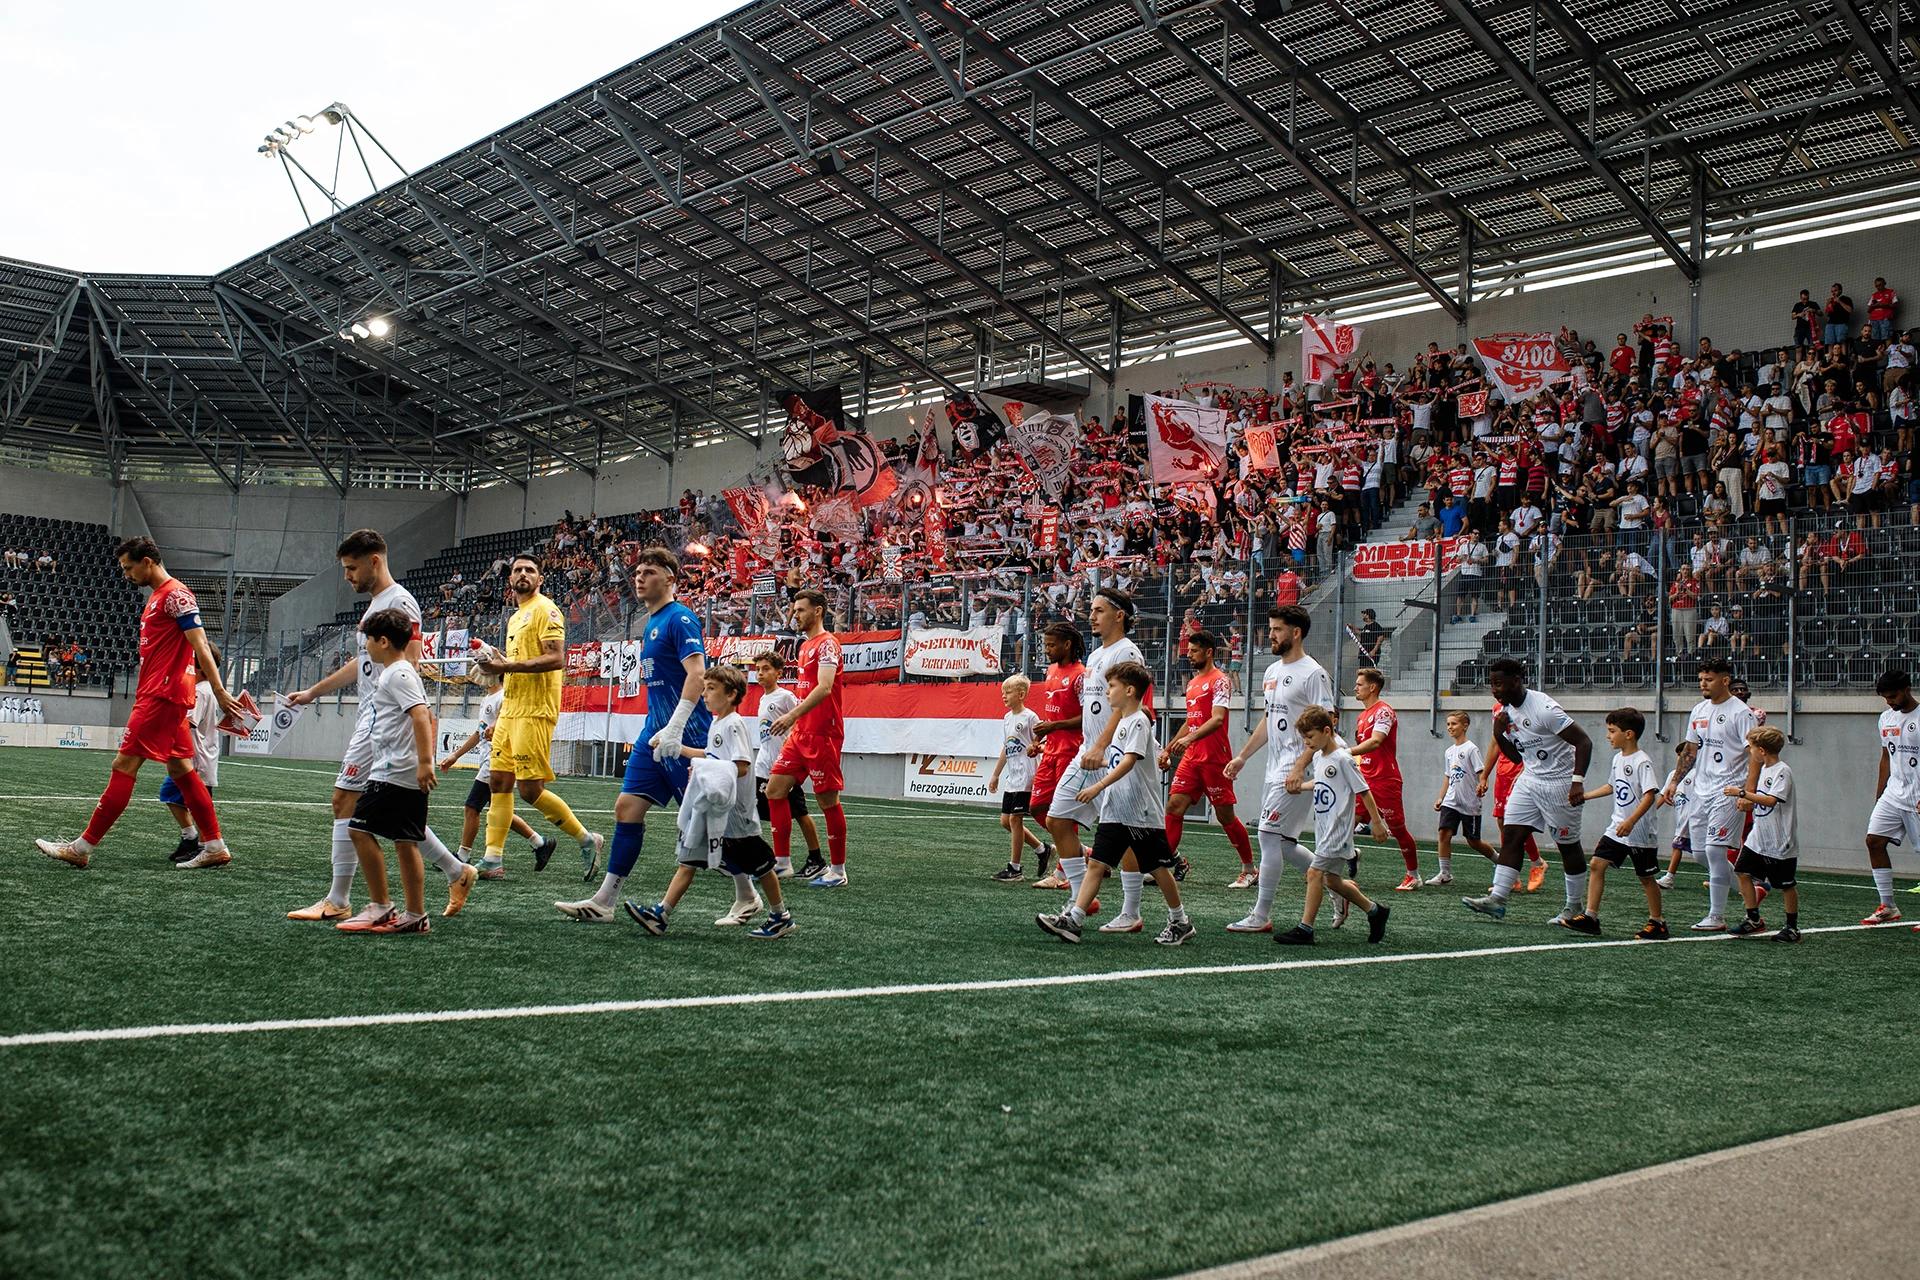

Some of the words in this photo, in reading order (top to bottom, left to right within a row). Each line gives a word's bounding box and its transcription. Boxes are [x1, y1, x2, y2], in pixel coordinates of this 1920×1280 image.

[1501, 343, 1556, 368] 8400
[1353, 557, 1462, 579] CRIS
[865, 646, 898, 667] Jungs
[60, 739, 89, 747] BMapp
[938, 758, 978, 774] ZÄUNE
[910, 780, 988, 797] herzogzäune.ch
